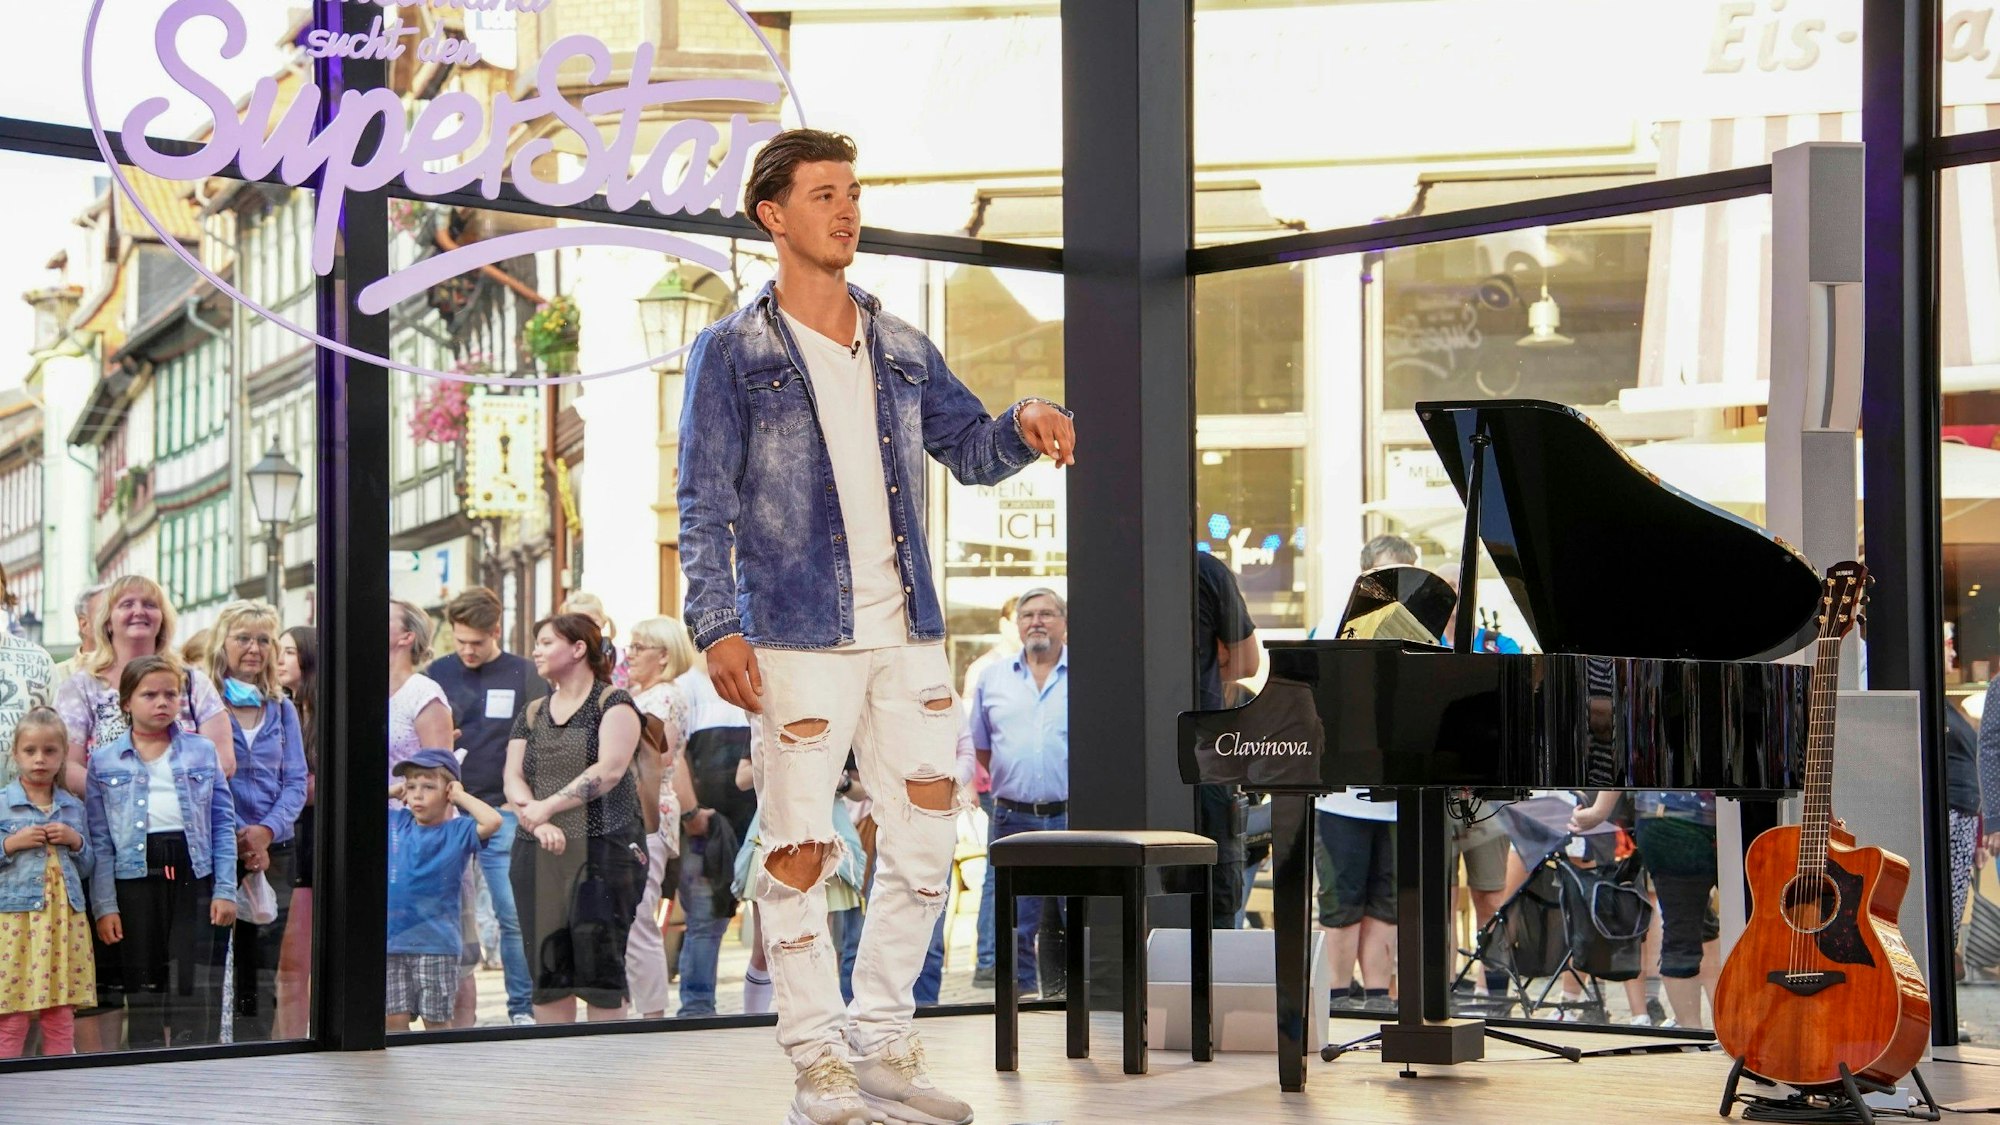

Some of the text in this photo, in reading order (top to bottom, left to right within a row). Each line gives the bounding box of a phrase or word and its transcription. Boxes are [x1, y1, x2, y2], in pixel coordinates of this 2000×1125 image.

[307, 15, 483, 65] sucht den
[1703, 2, 1858, 74] Eis-
[977, 480, 1033, 498] MEIN
[999, 513, 1055, 539] ICH
[1215, 732, 1312, 756] Clavinova.
